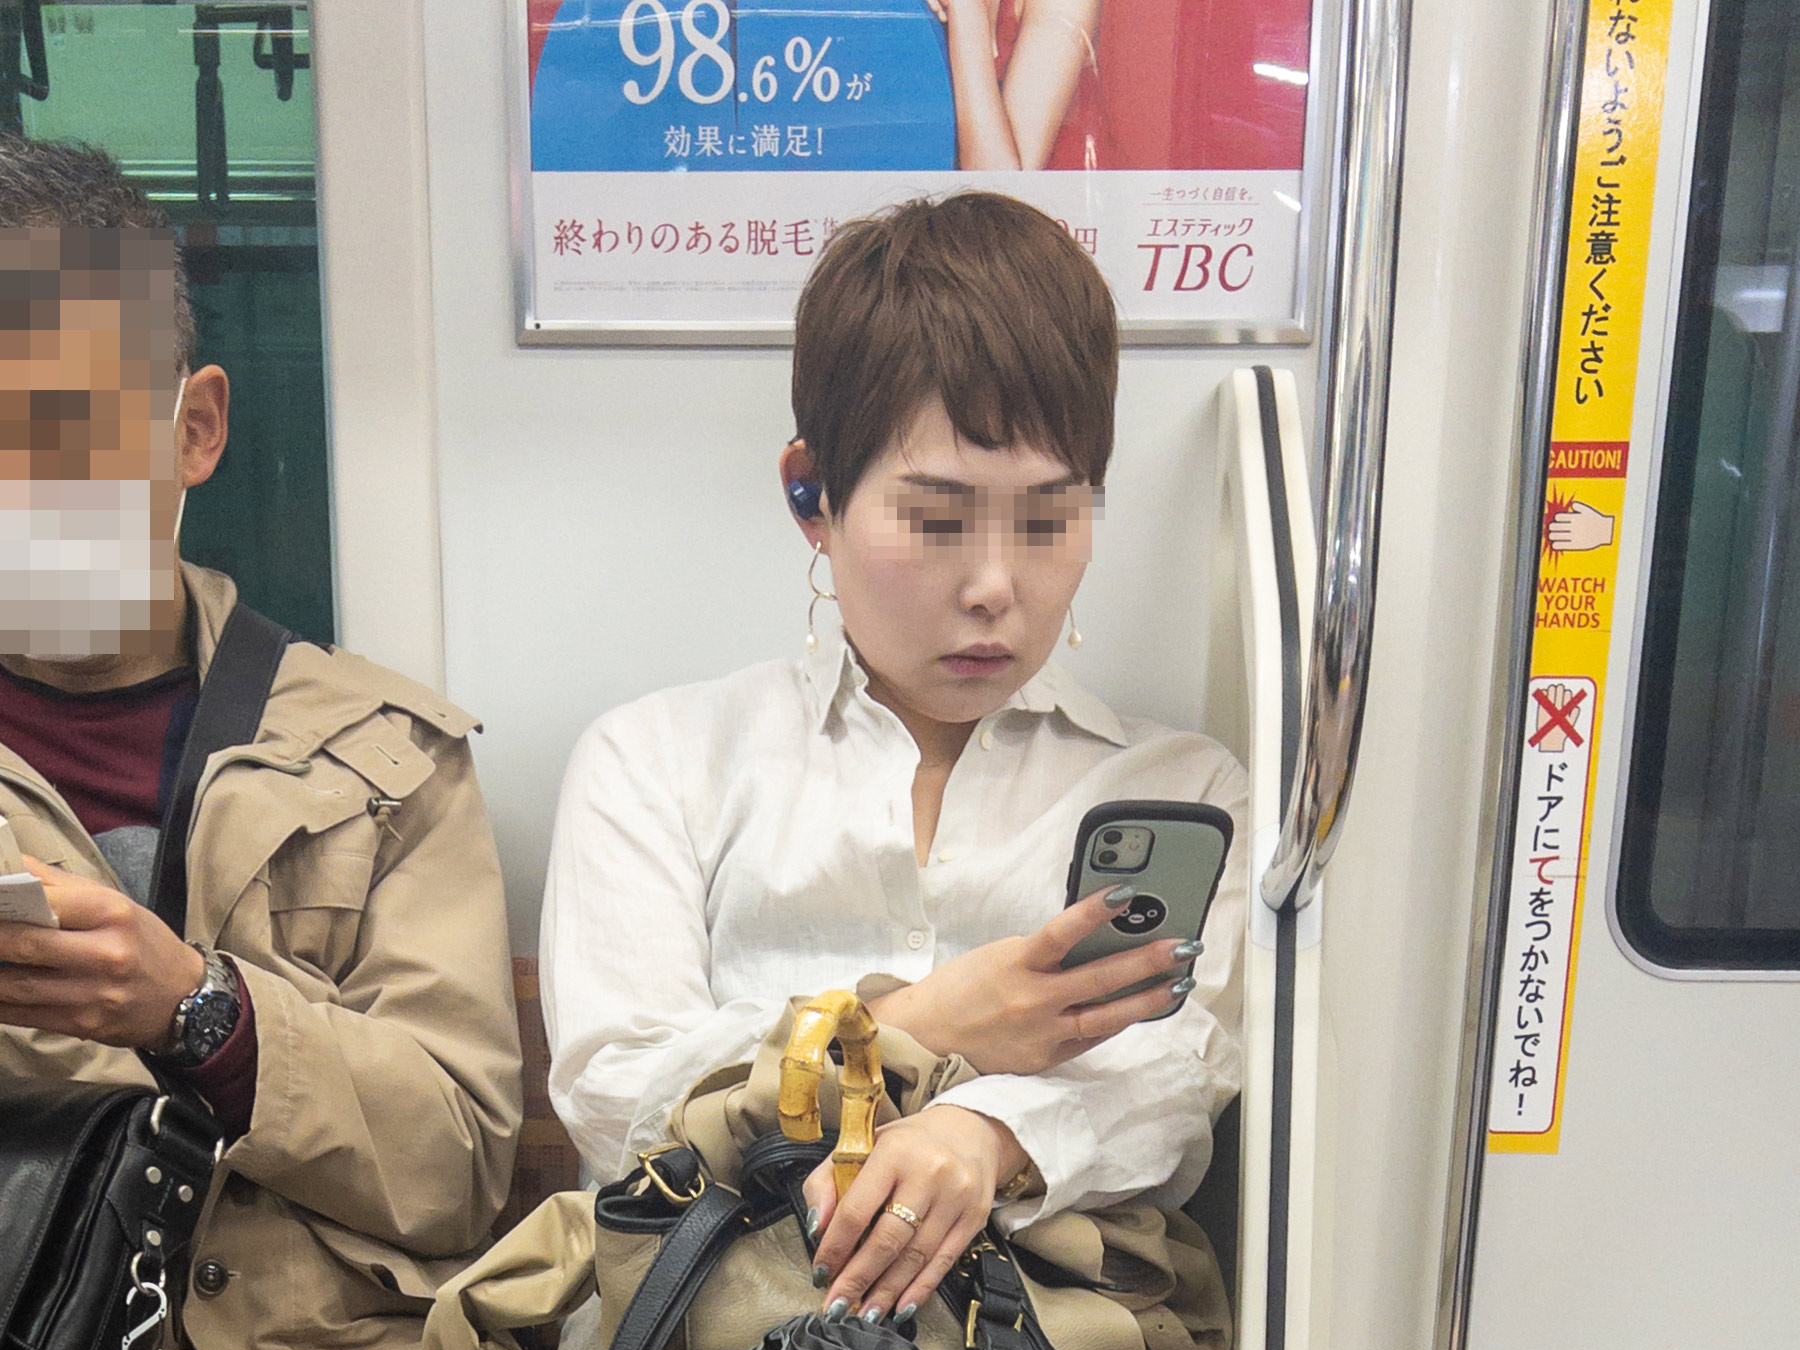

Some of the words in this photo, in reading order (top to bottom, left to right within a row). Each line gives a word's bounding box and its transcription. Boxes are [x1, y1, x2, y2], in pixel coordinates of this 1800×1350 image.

[663, 124, 823, 157] 効果に満足!
[1150, 186, 1253, 201] 一生つづく自信を。
[1575, 0, 1638, 405] ないようご注意ください
[553, 217, 814, 256] 終わりのある脱毛
[1146, 218, 1254, 237] エステティック
[1137, 243, 1254, 292] TBC
[1538, 577, 1606, 593] WATCH
[1544, 595, 1596, 611] YOUR
[1535, 613, 1601, 629] HANDS
